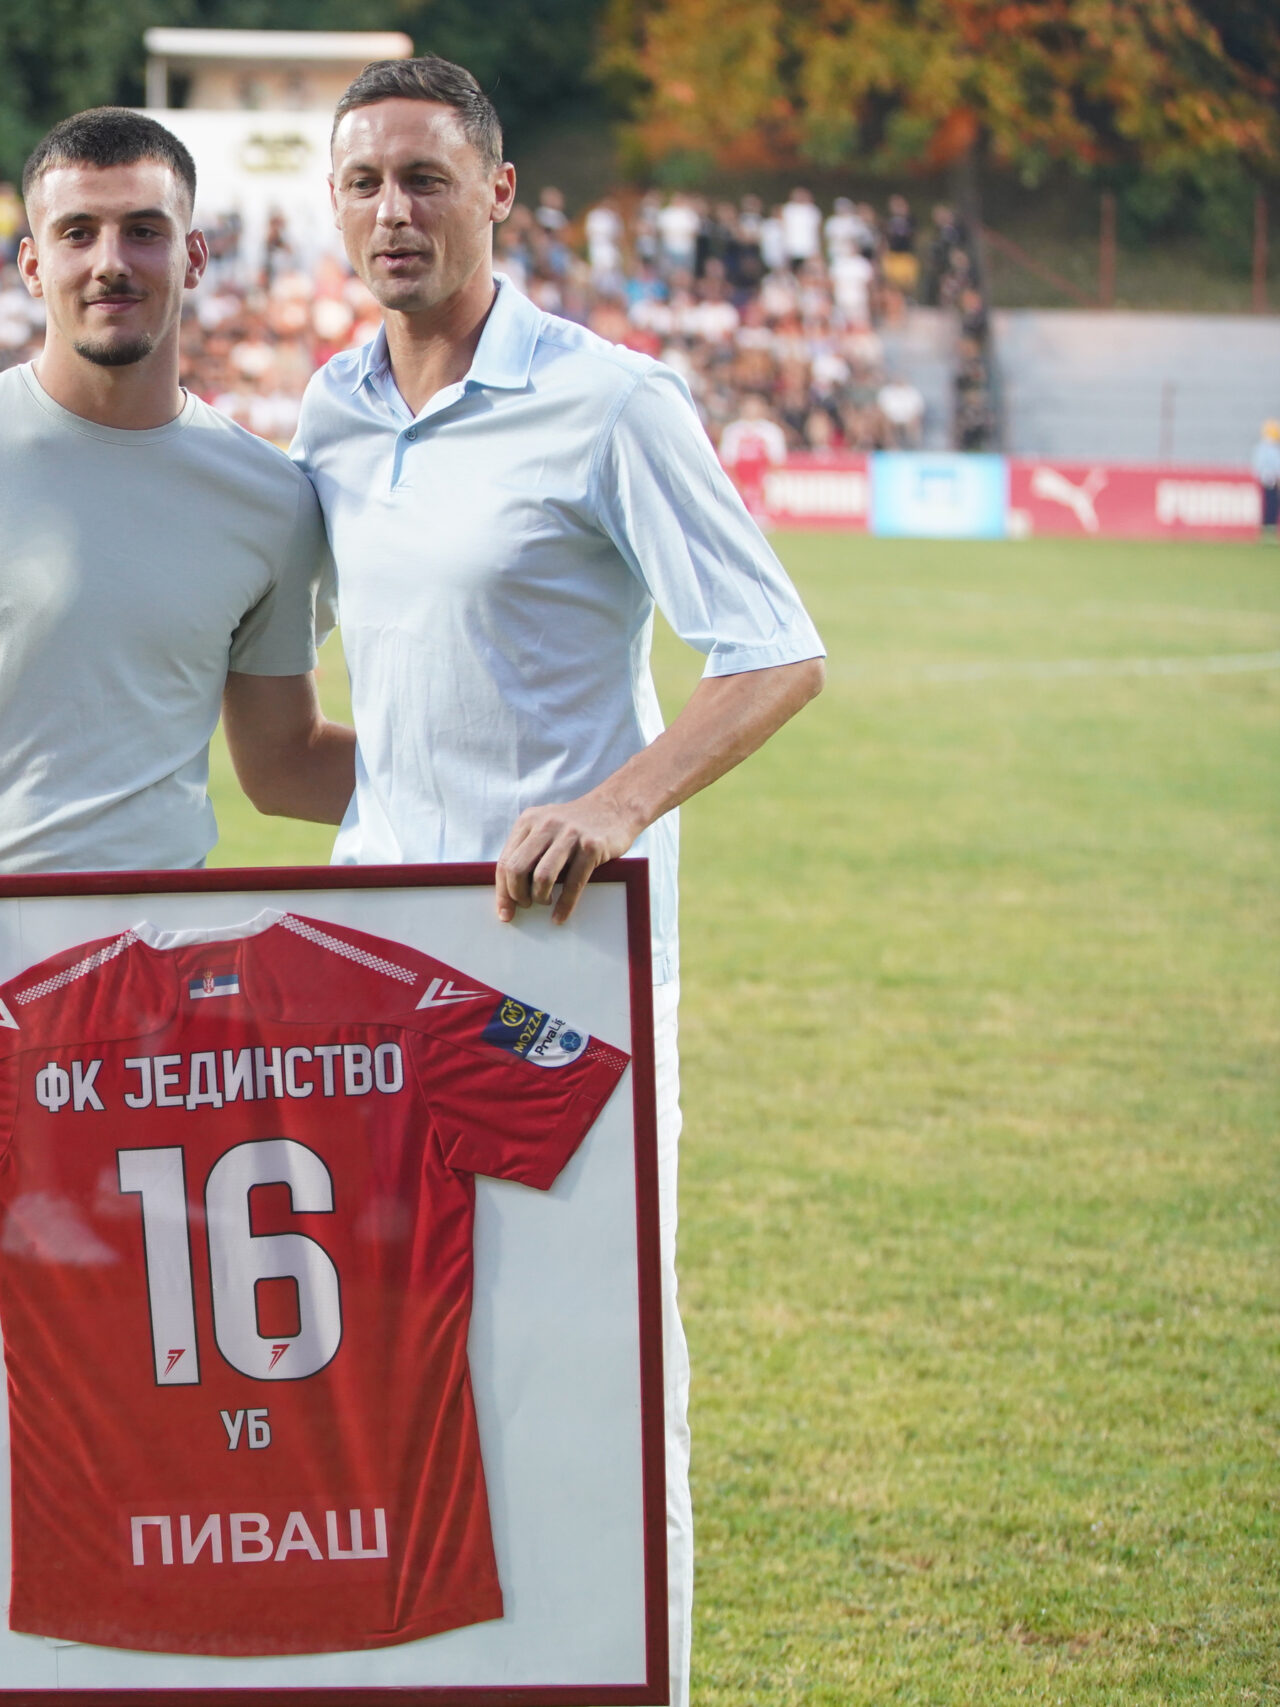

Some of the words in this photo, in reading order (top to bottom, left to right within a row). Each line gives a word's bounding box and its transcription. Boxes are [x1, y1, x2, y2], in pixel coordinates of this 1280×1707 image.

[34, 1059, 107, 1114] ФК
[123, 1042, 406, 1111] ЈЕДИНСТВО
[115, 1137, 344, 1386] 16
[218, 1407, 273, 1452] УБ
[130, 1507, 389, 1567] ПИВАШ
